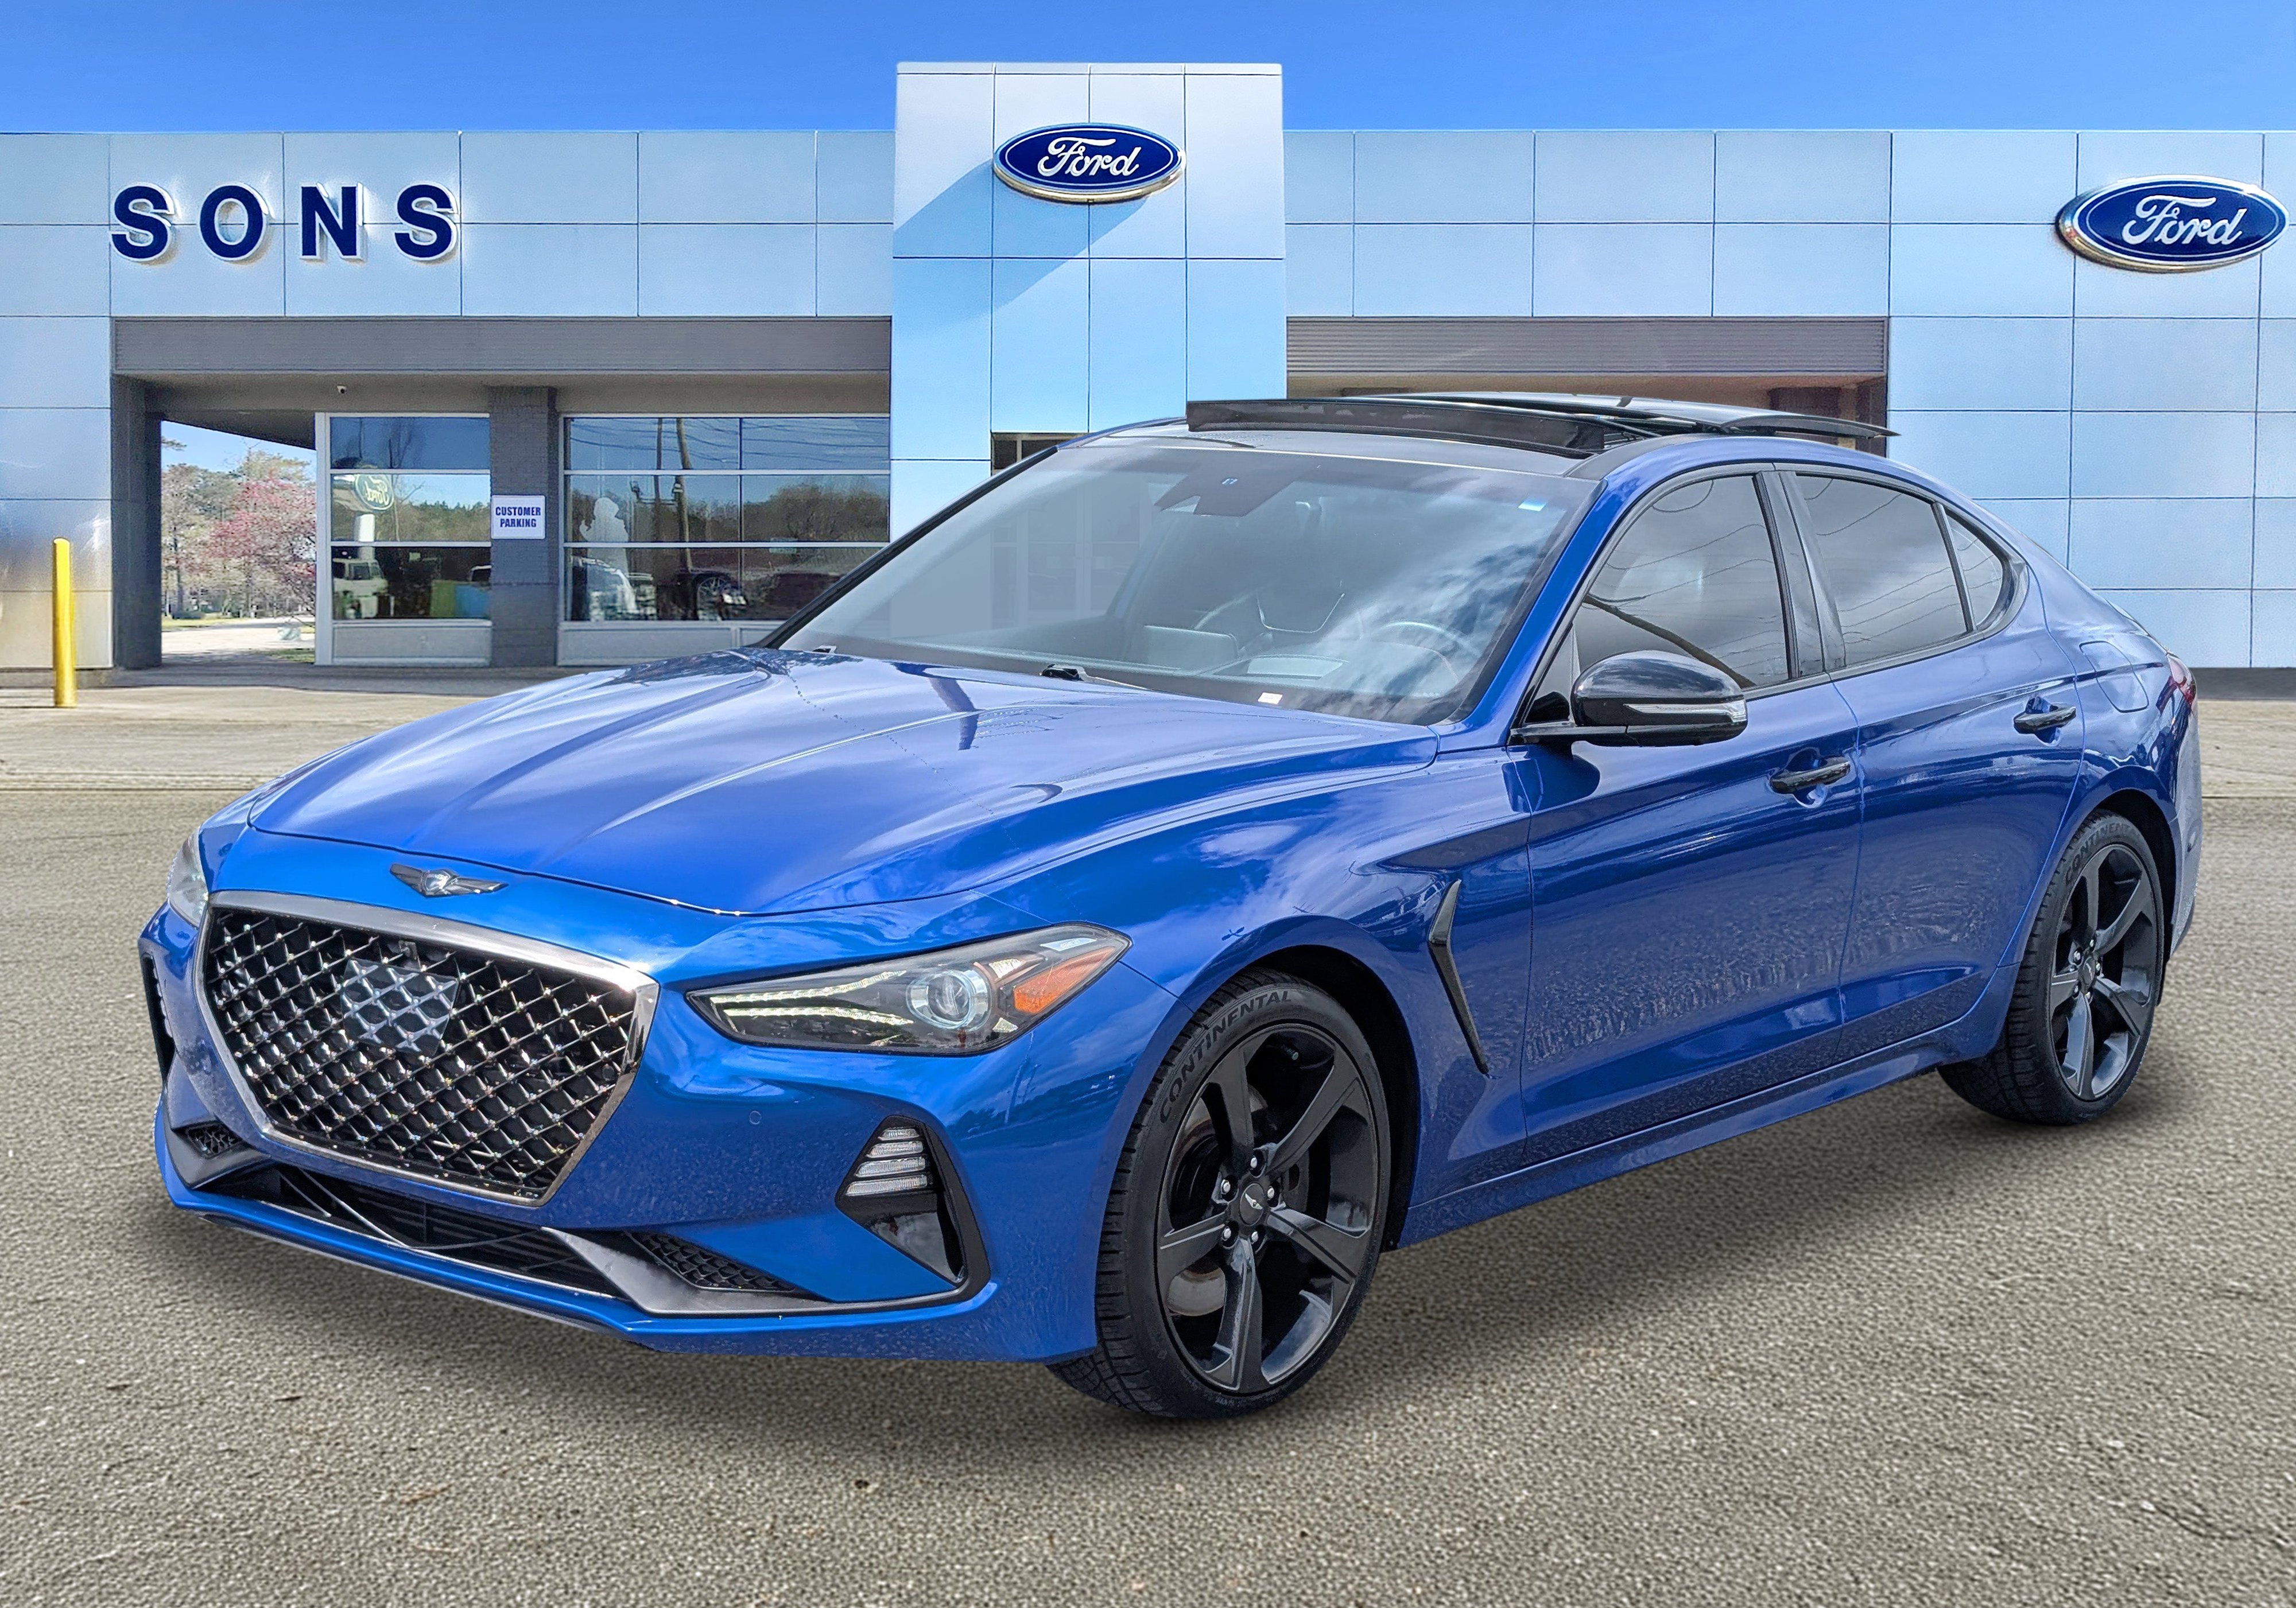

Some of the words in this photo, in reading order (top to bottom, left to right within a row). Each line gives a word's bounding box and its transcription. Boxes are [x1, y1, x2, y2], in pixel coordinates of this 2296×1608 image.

[1037, 137, 1142, 177] Ford
[111, 183, 458, 260] SONS
[2122, 195, 2247, 245] Ford
[495, 507, 541, 516] CUSTOMER
[500, 519, 537, 527] PARKING
[2065, 821, 2133, 885] CONTINENT
[1159, 991, 1292, 1124] CONTINENTAL
